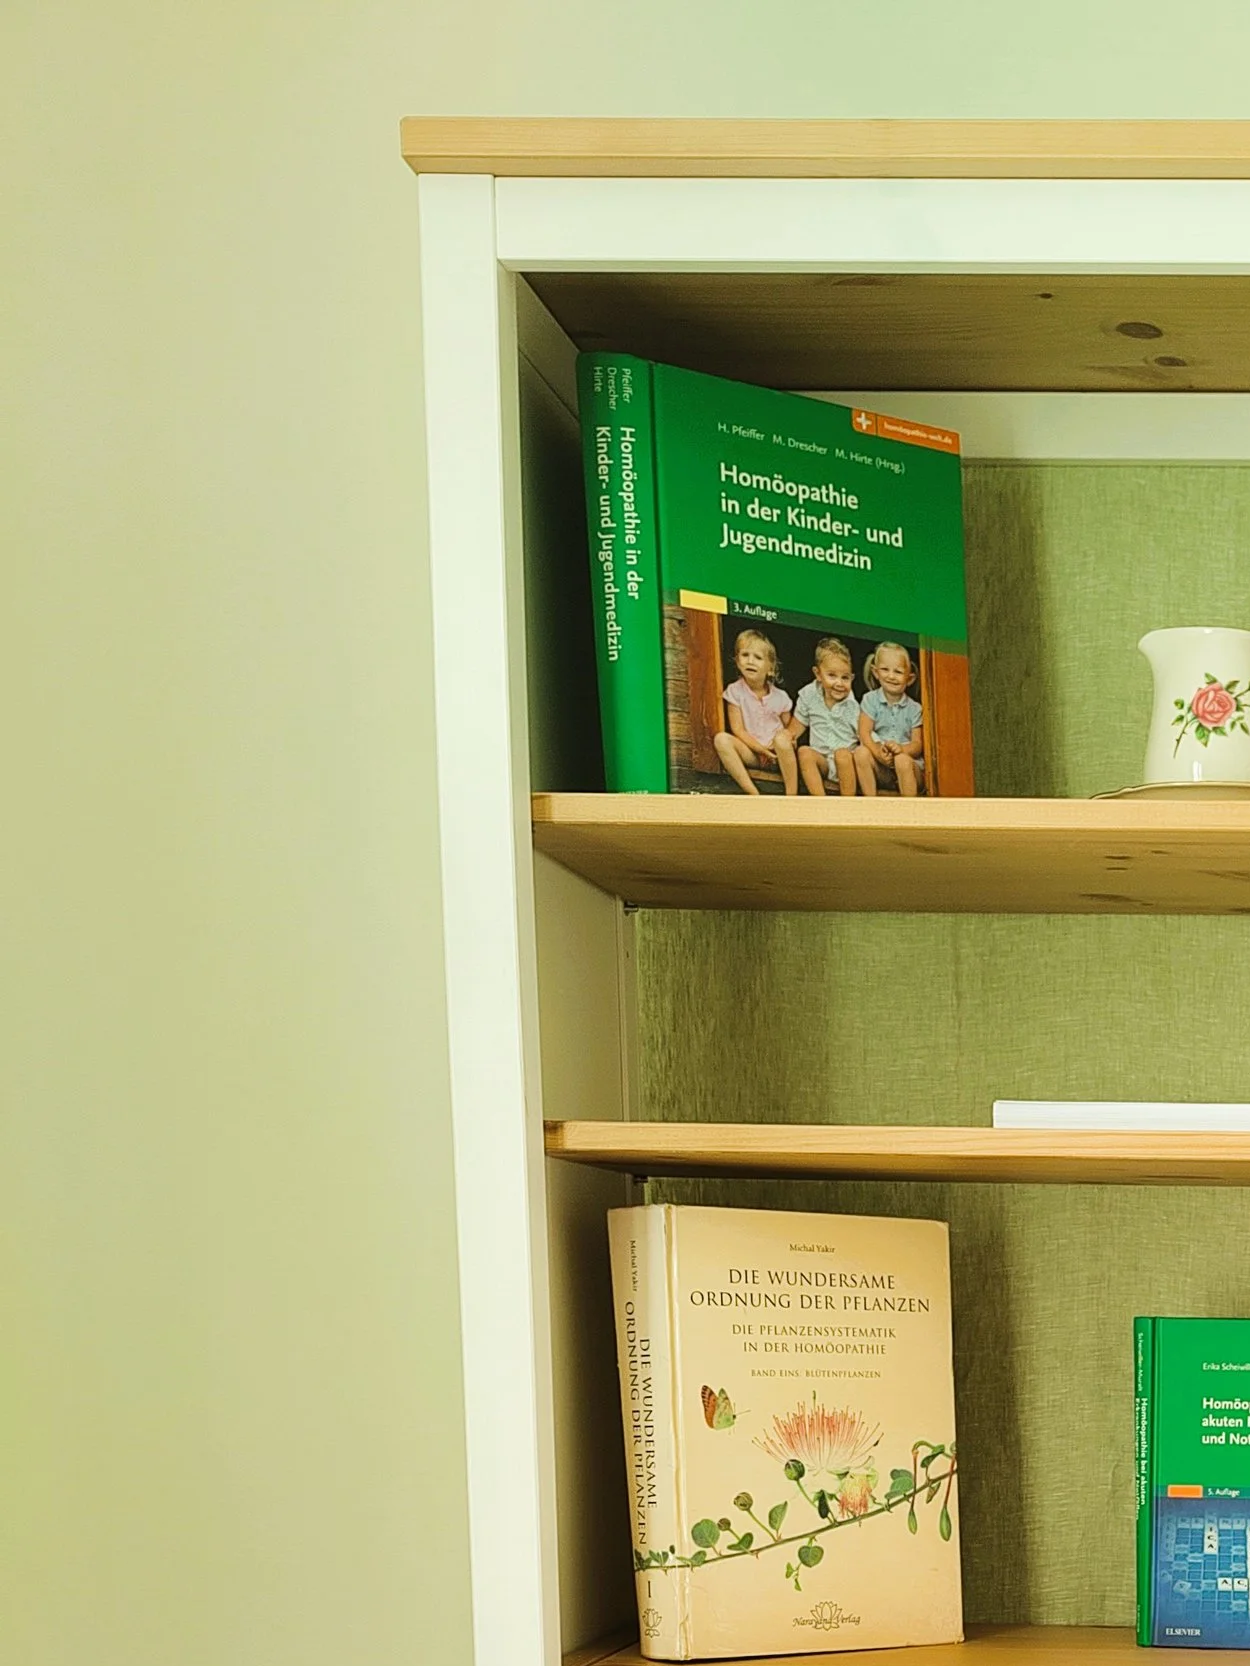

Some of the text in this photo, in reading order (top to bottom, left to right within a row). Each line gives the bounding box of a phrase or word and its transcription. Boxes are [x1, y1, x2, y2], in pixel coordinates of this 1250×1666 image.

[593, 366, 604, 393] Hirte
[607, 367, 619, 411] Drescher
[622, 367, 633, 404] Pfeiffer
[717, 422, 906, 474] H. Pfeiffer M. Drescher M. Hirte (Hrsg.)
[719, 462, 859, 509] Homöopathie
[618, 426, 644, 600] Homöopathie in der
[720, 492, 903, 548] in der Kinder- und
[596, 426, 623, 662] Kinder- und Jugendmedizin
[719, 523, 872, 570] Jugendmedizin
[733, 602, 778, 620] 3. Auflage
[789, 1242, 836, 1254] Michal Yakir
[729, 1268, 896, 1290] DIE WUNDERSAME
[690, 1290, 930, 1313] ORDNUNG DER PFLANZEN
[732, 1323, 897, 1339] DIE PFLANZENSYSTEMATIK
[743, 1341, 887, 1355] IN DER HOMÖOPATHIE
[751, 1368, 776, 1378] BAND
[805, 1367, 881, 1379] BLÜTENPFLANZEN
[1202, 1362, 1221, 1371] Erika
[625, 1301, 647, 1545] ORDNUNG DER PFLANZEN
[639, 1338, 658, 1509] DIE WUNDERSAME
[1202, 1415, 1243, 1427] akuten
[1201, 1432, 1226, 1444] und
[1140, 1397, 1148, 1506] Homöopathie bei akuten
[1214, 1487, 1240, 1498] Auflage
[1165, 1627, 1201, 1636] ELSEVIER
